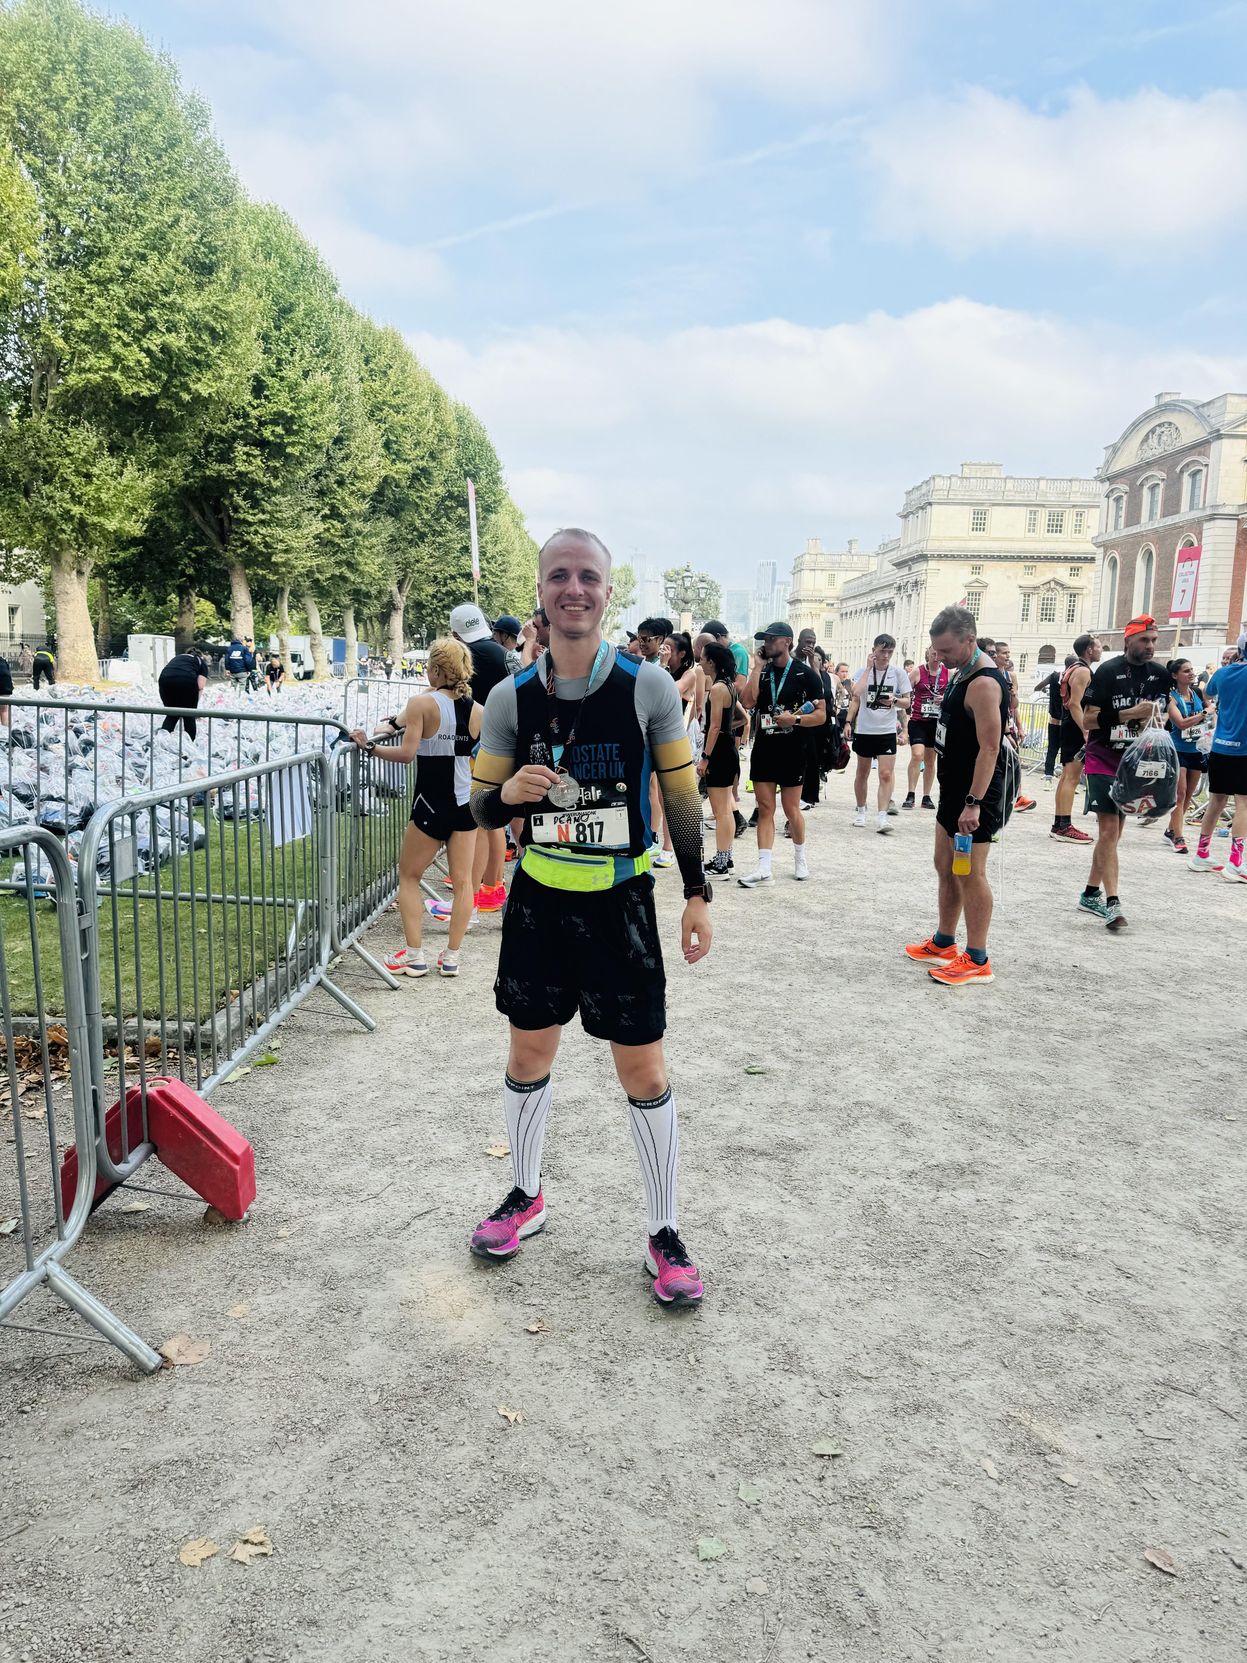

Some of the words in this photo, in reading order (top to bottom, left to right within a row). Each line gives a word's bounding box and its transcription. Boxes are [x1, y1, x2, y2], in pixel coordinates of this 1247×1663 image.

[1180, 589, 1186, 604] 7
[438, 734, 469, 742] ROADENTS
[571, 743, 621, 763] OSTATE
[571, 762, 607, 780] NCER
[609, 762, 626, 779] UK
[1142, 770, 1159, 778] 7166
[557, 824, 571, 843] N
[575, 822, 605, 843] 817
